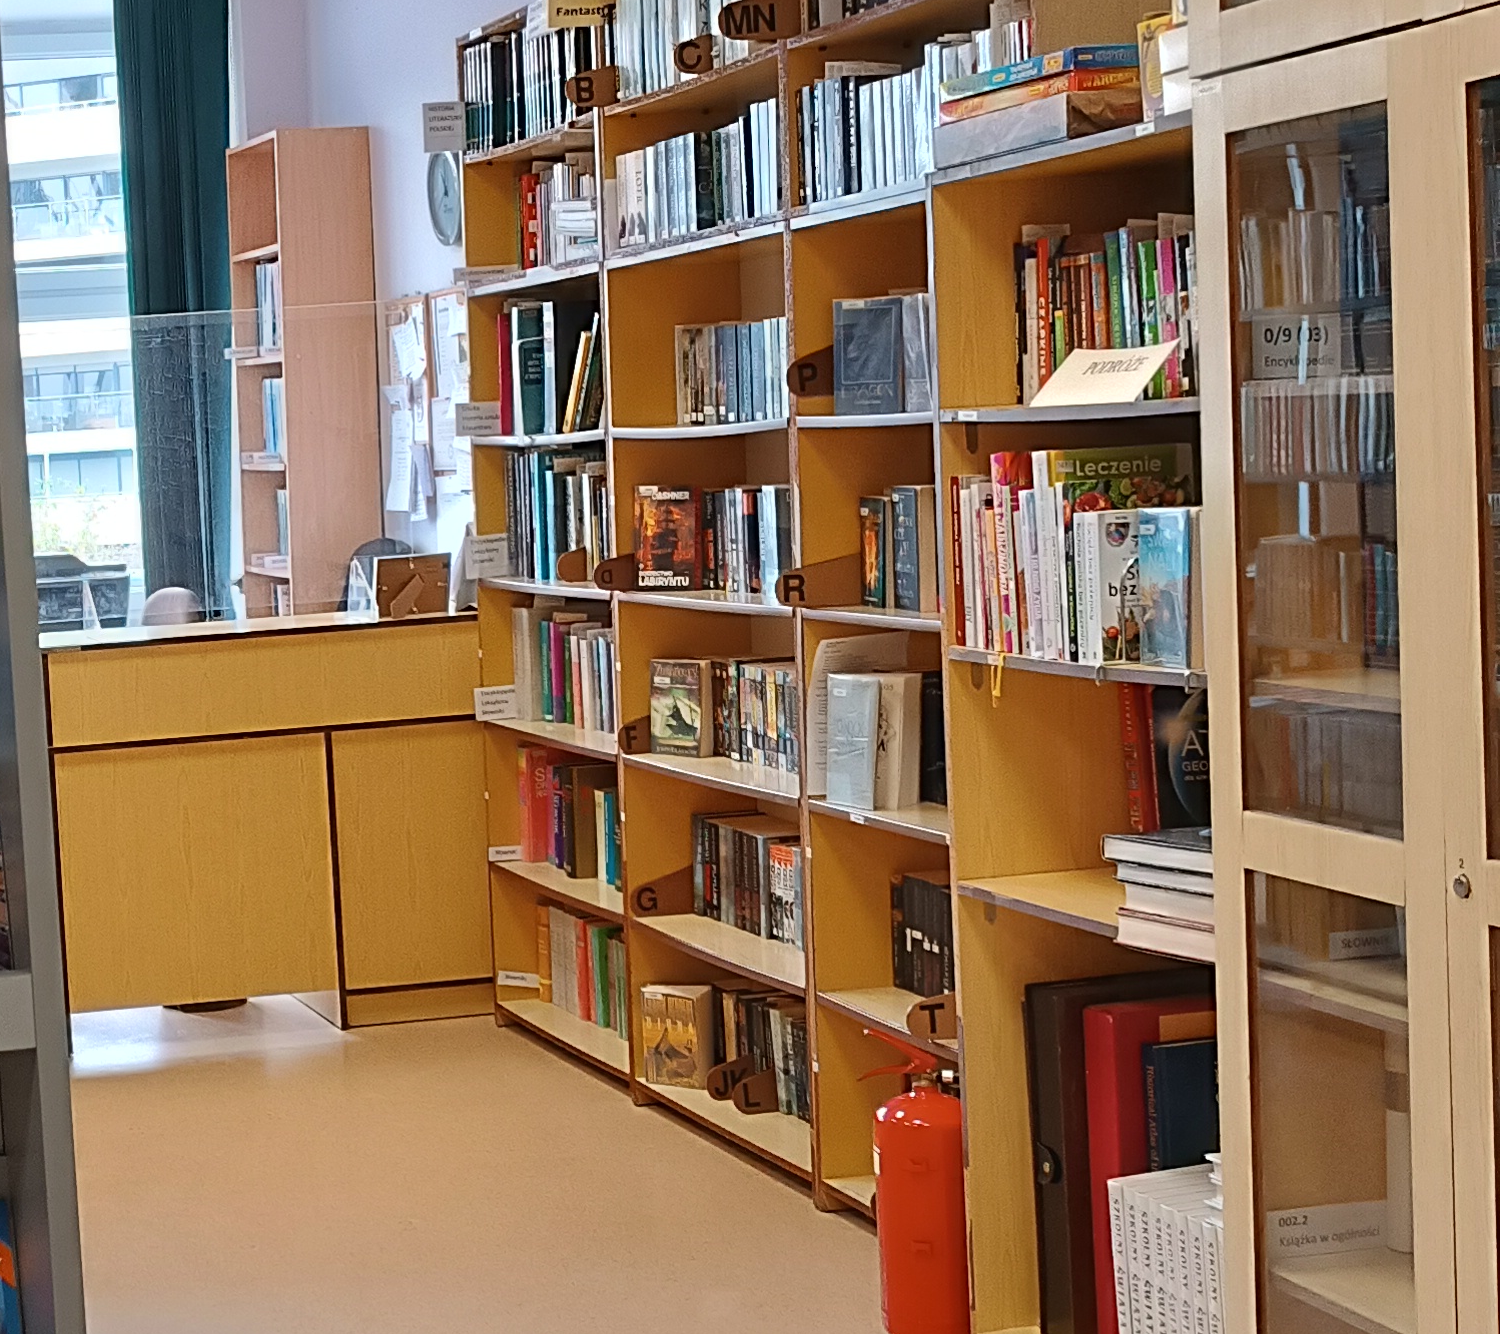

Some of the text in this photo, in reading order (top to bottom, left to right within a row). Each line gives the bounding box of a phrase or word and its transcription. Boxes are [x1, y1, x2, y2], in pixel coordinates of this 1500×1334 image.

[724, 3, 776, 35] MN
[675, 41, 702, 69] C
[575, 77, 594, 102] B
[1264, 326, 1292, 346] 0/9
[797, 363, 818, 392] P
[1082, 355, 1149, 375] PODRÓŻE
[1075, 457, 1162, 477] Leczenie
[783, 574, 805, 602] R
[1109, 583, 1137, 597] bez
[624, 725, 637, 750] F
[636, 887, 657, 912] G
[919, 1003, 945, 1034] T
[743, 1083, 761, 1108] L
[1148, 1120, 1157, 1148] Atlas
[1129, 1205, 1137, 1263] SZKOLNY
[1141, 1211, 1151, 1269] SZKOLNY
[1156, 1218, 1164, 1276] SZKOLNY
[1319, 1235, 1328, 1243] w
[1113, 1199, 1127, 1328] SZKOLNY ŚWIATA
[1179, 1229, 1189, 1289] SZKOLNY
[1193, 1237, 1203, 1296] SZKOLNY
[1208, 1242, 1218, 1303] SZKOLNY
